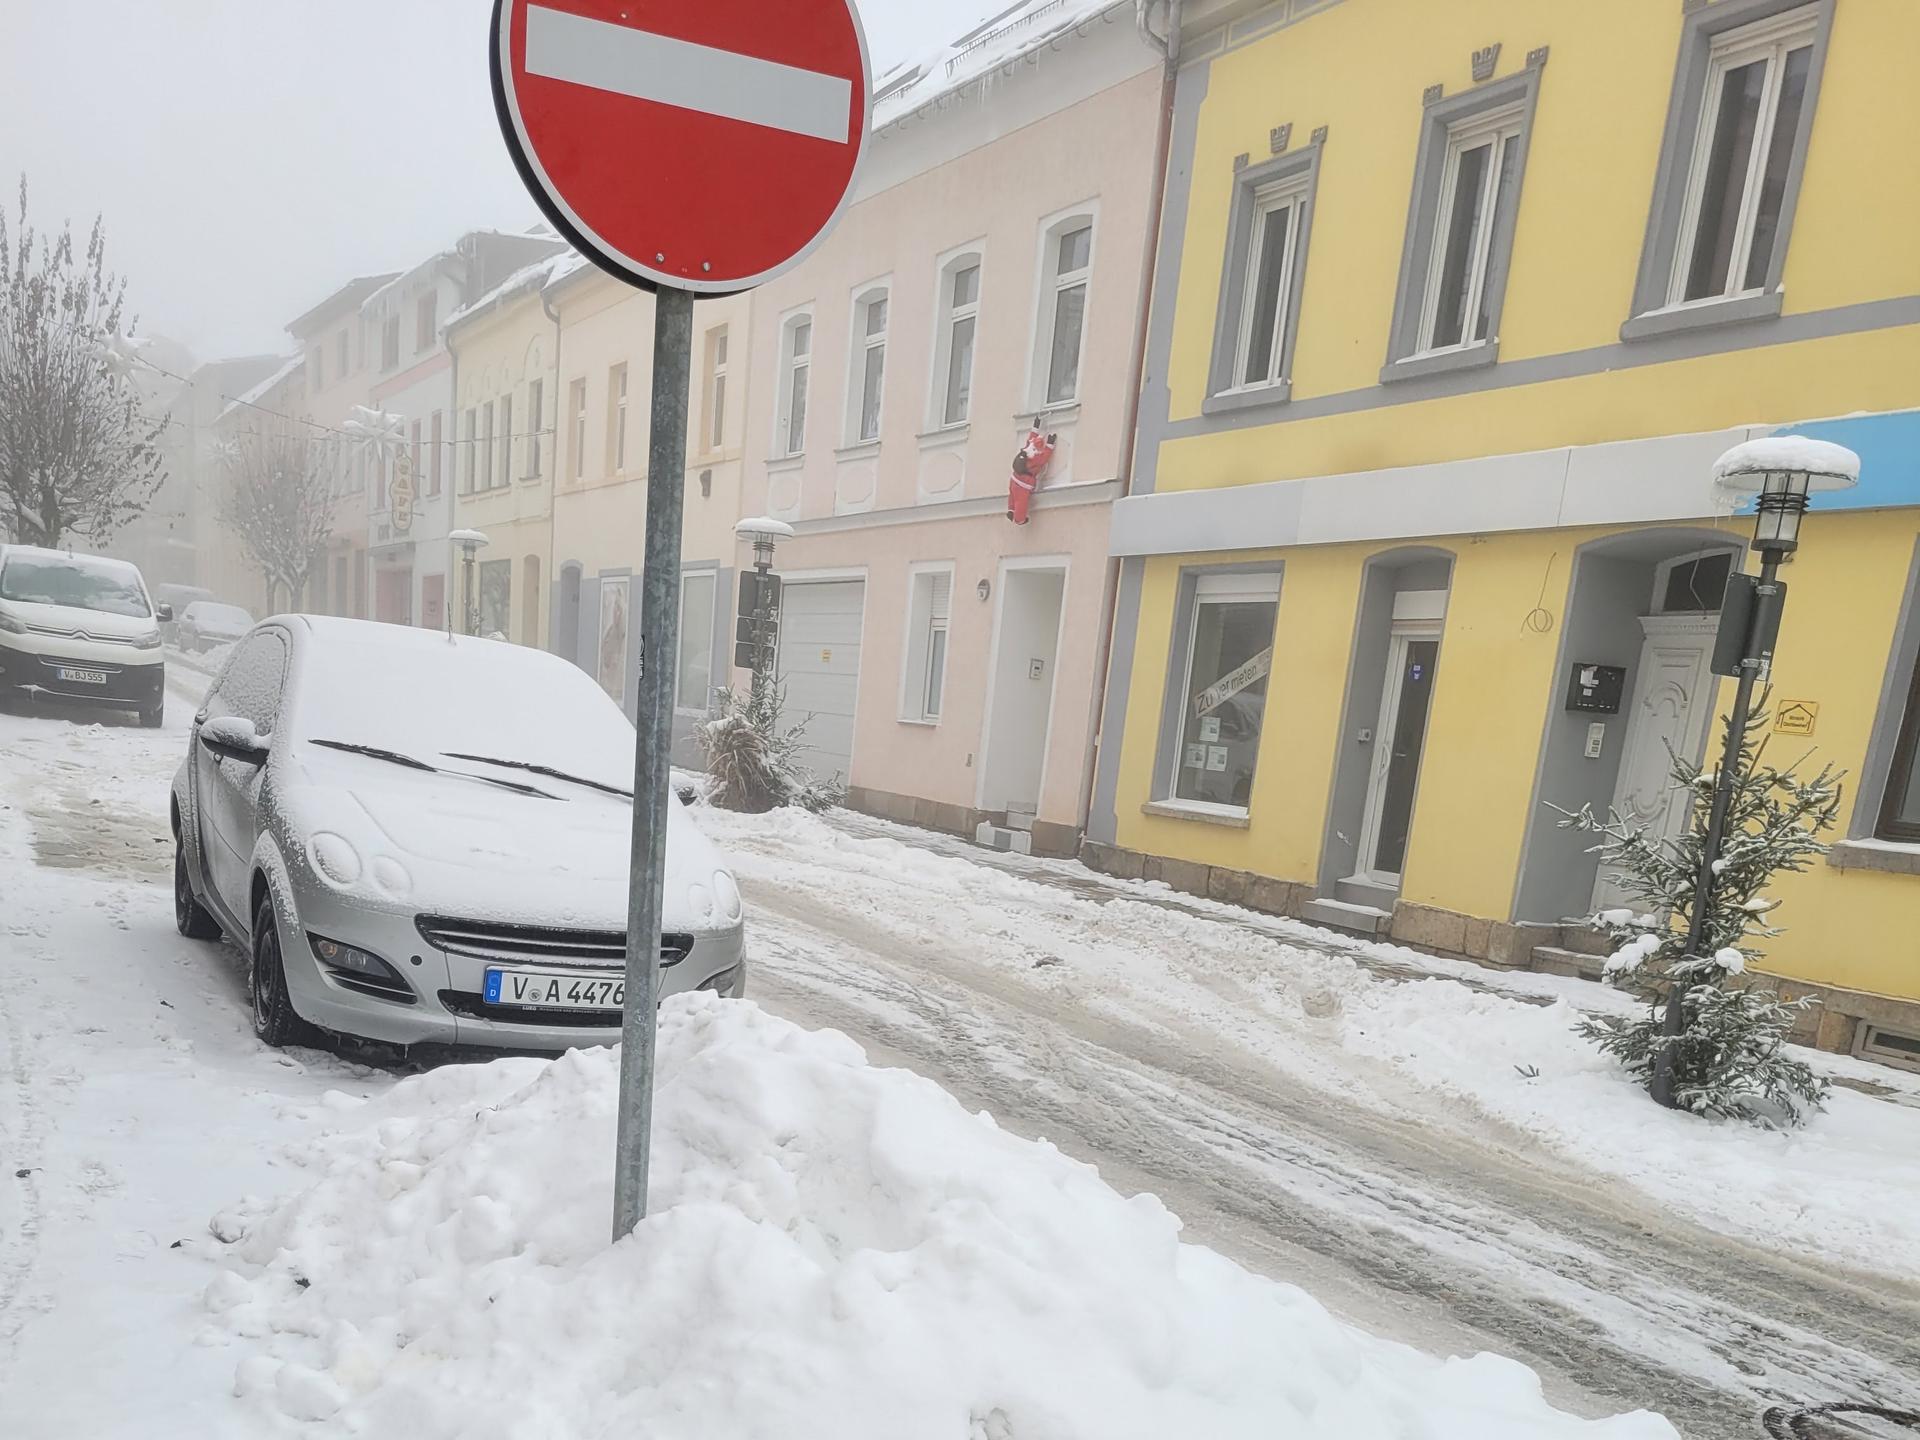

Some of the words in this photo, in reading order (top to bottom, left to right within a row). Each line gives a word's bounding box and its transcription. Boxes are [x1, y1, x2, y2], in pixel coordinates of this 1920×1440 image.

[64, 670, 70, 678] V
[1198, 694, 1213, 714] Zu
[489, 989, 497, 997] D
[513, 977, 529, 1000] V
[545, 979, 560, 1003] A
[567, 981, 626, 1006] 4476
